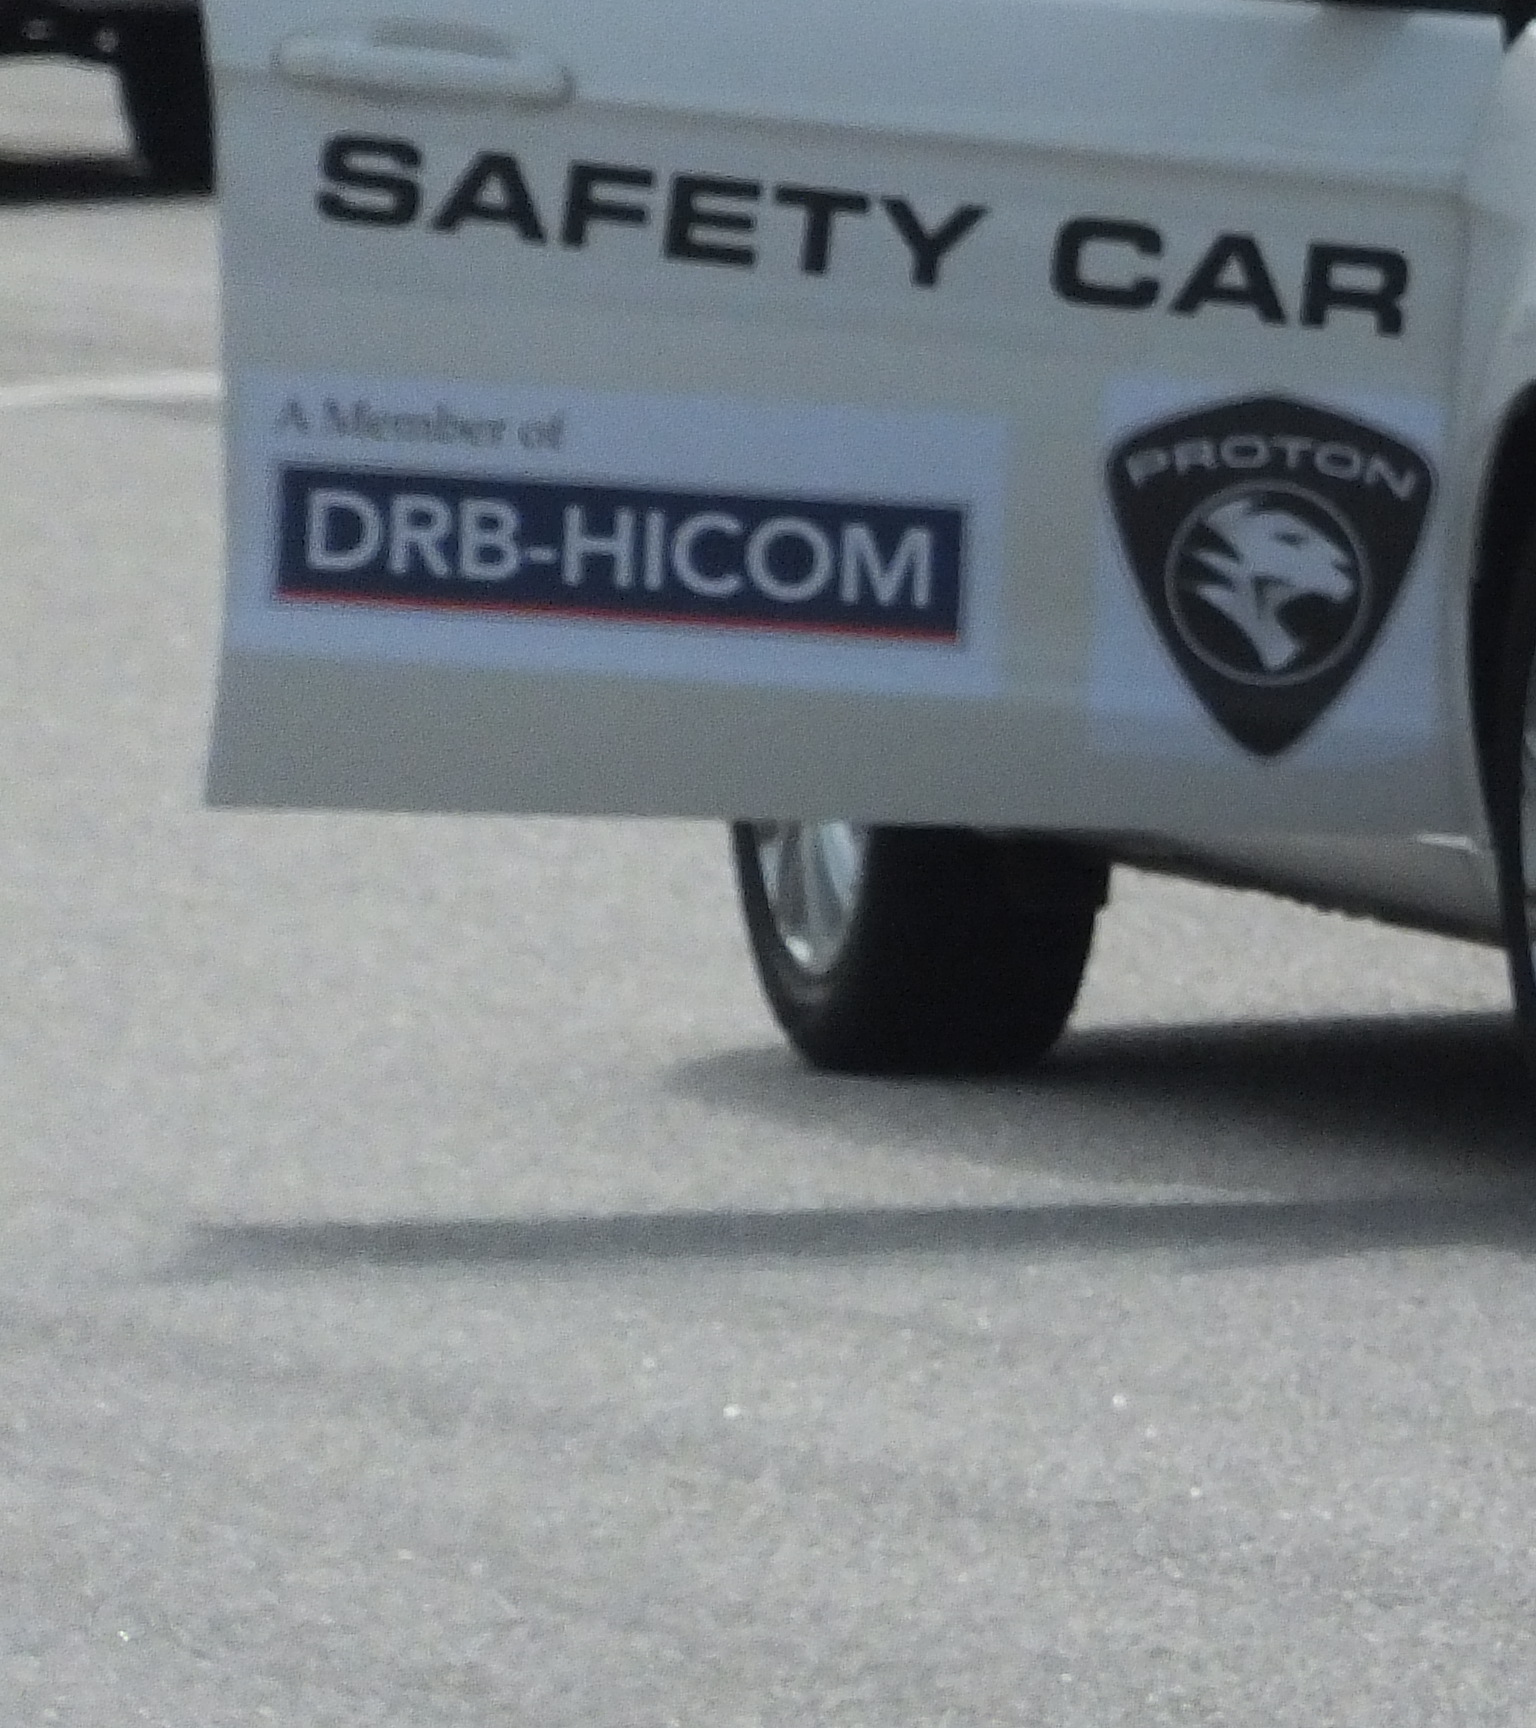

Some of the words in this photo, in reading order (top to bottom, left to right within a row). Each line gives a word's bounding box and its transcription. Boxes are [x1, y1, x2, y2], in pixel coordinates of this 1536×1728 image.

[316, 132, 988, 288] SAFETY
[1049, 215, 1410, 336] CAR
[322, 396, 506, 448] Member
[1126, 433, 1418, 501] PROTON
[304, 487, 934, 610] DRB-HICOM
